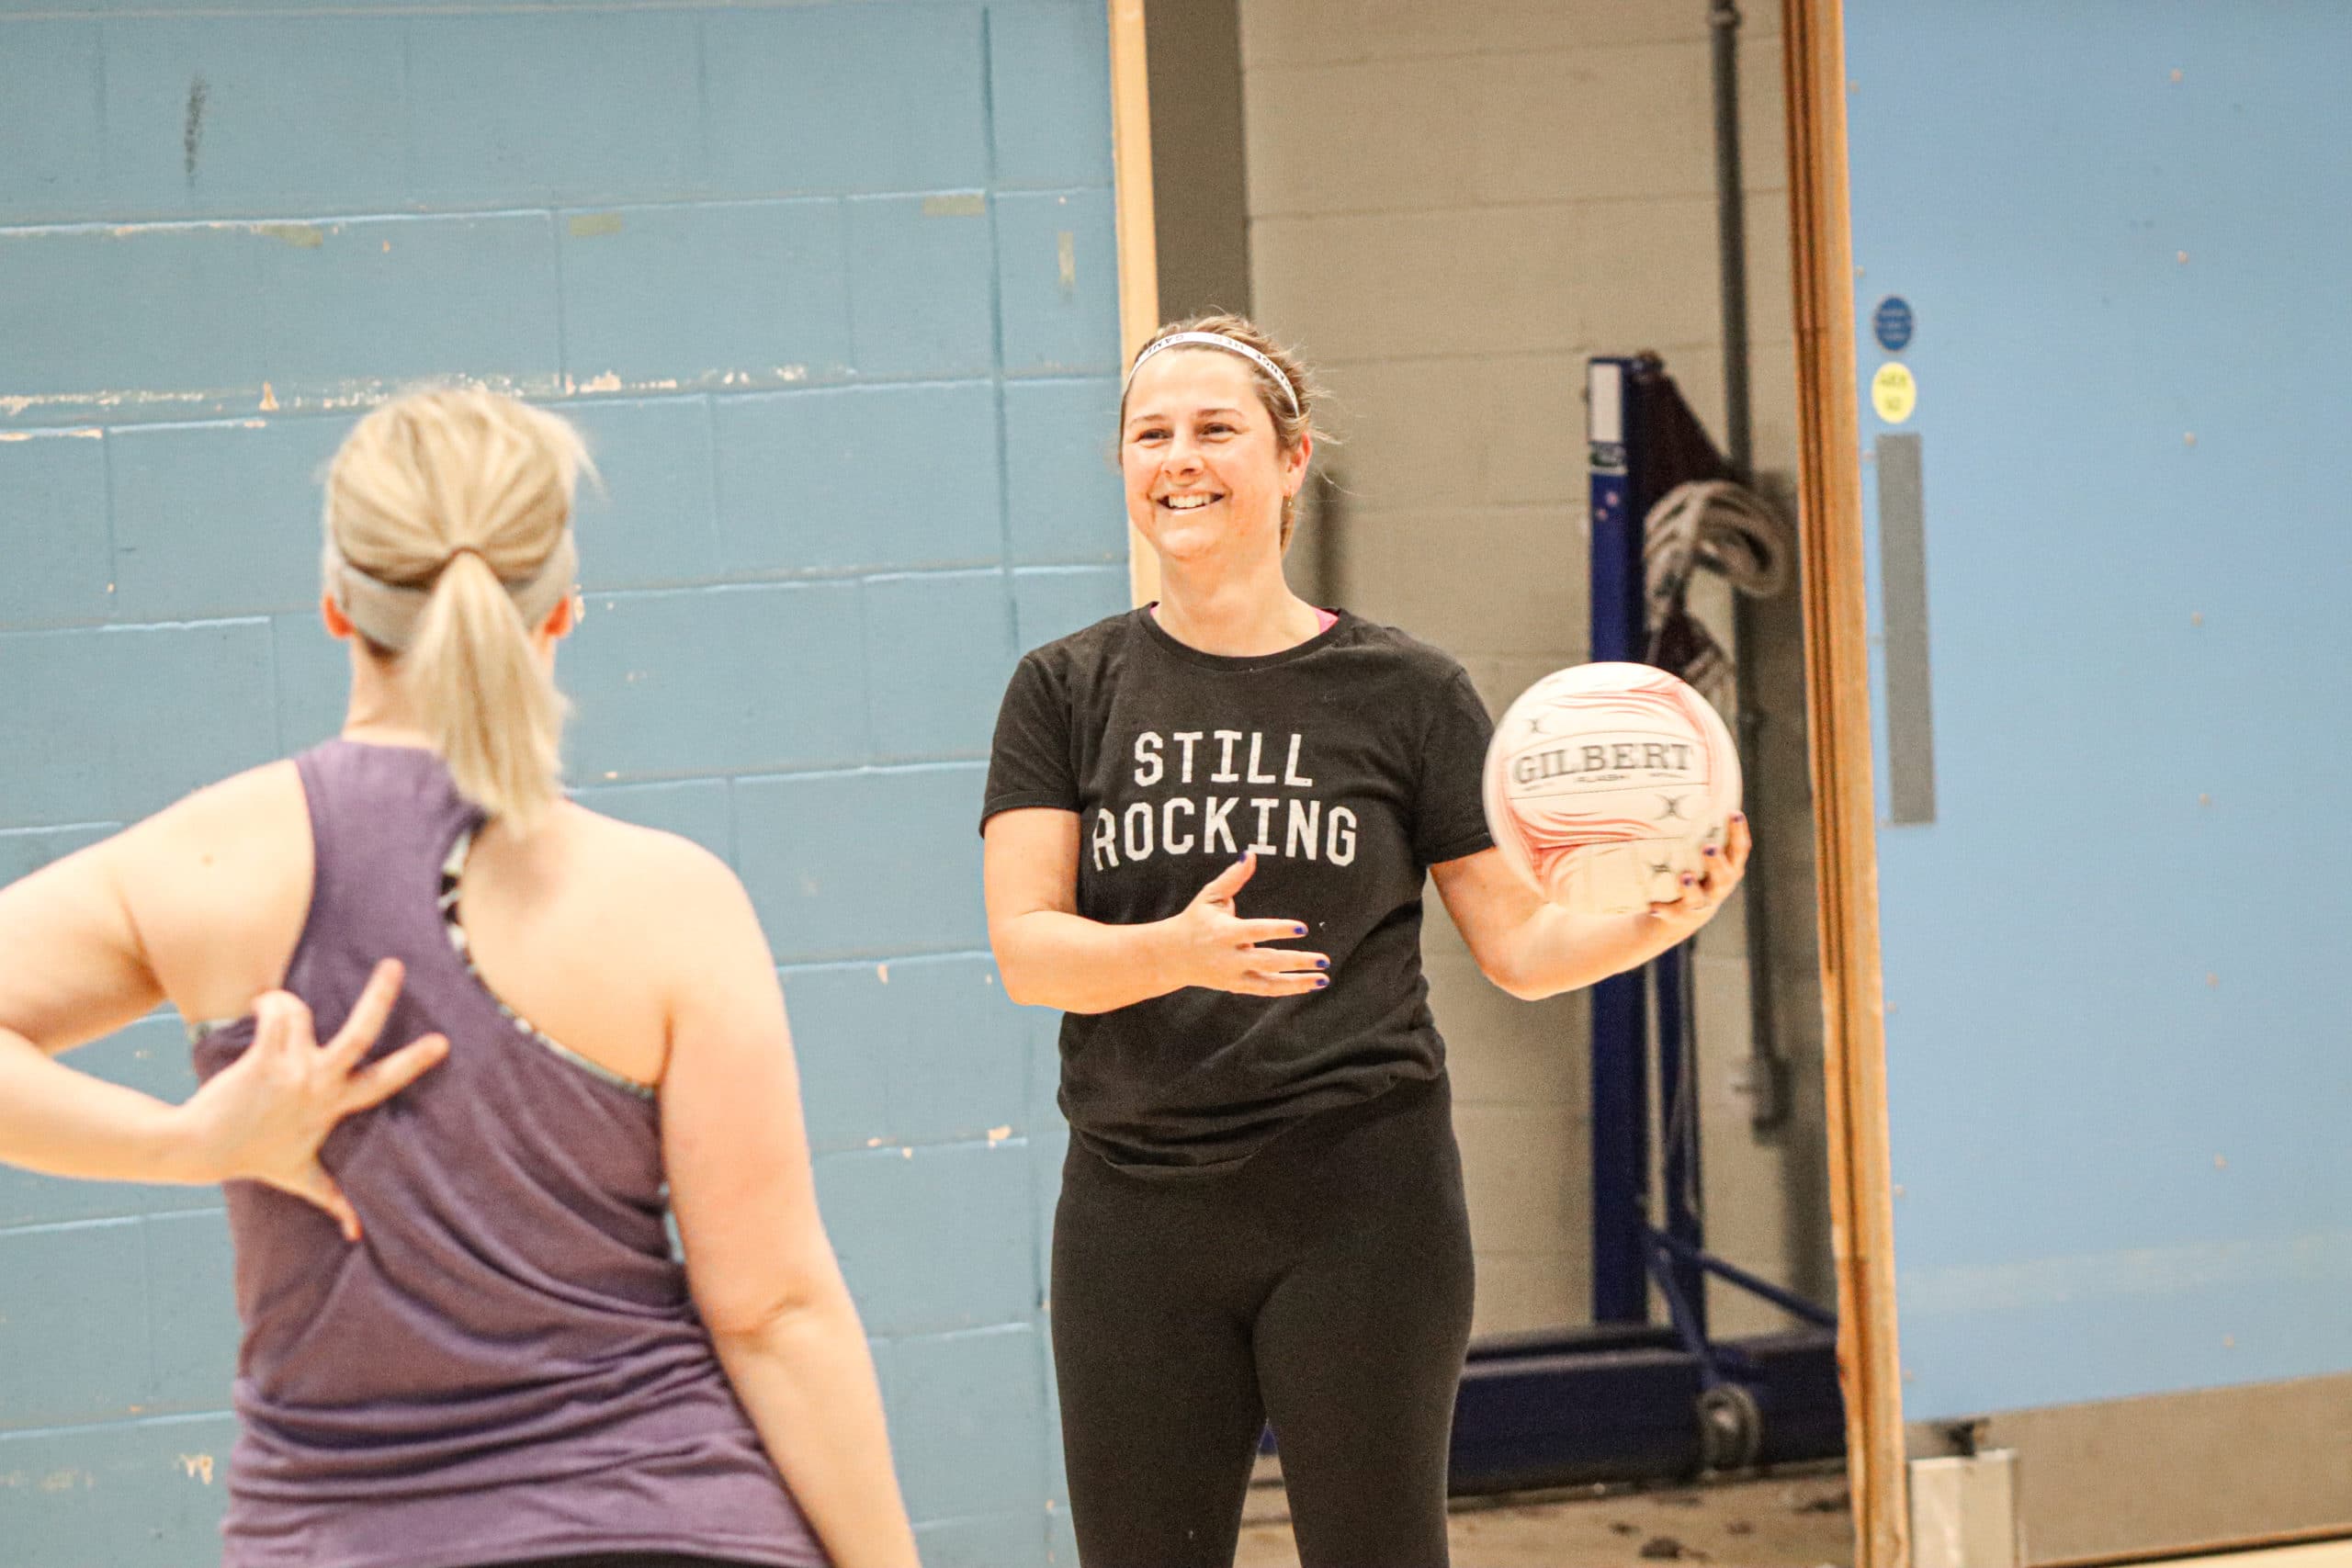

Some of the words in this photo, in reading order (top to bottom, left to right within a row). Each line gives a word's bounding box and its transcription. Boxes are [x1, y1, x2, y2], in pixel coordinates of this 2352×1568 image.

[1134, 730, 1313, 787] STILL
[1513, 742, 1691, 784] GILBERT
[1092, 796, 1357, 872] ROCKING
